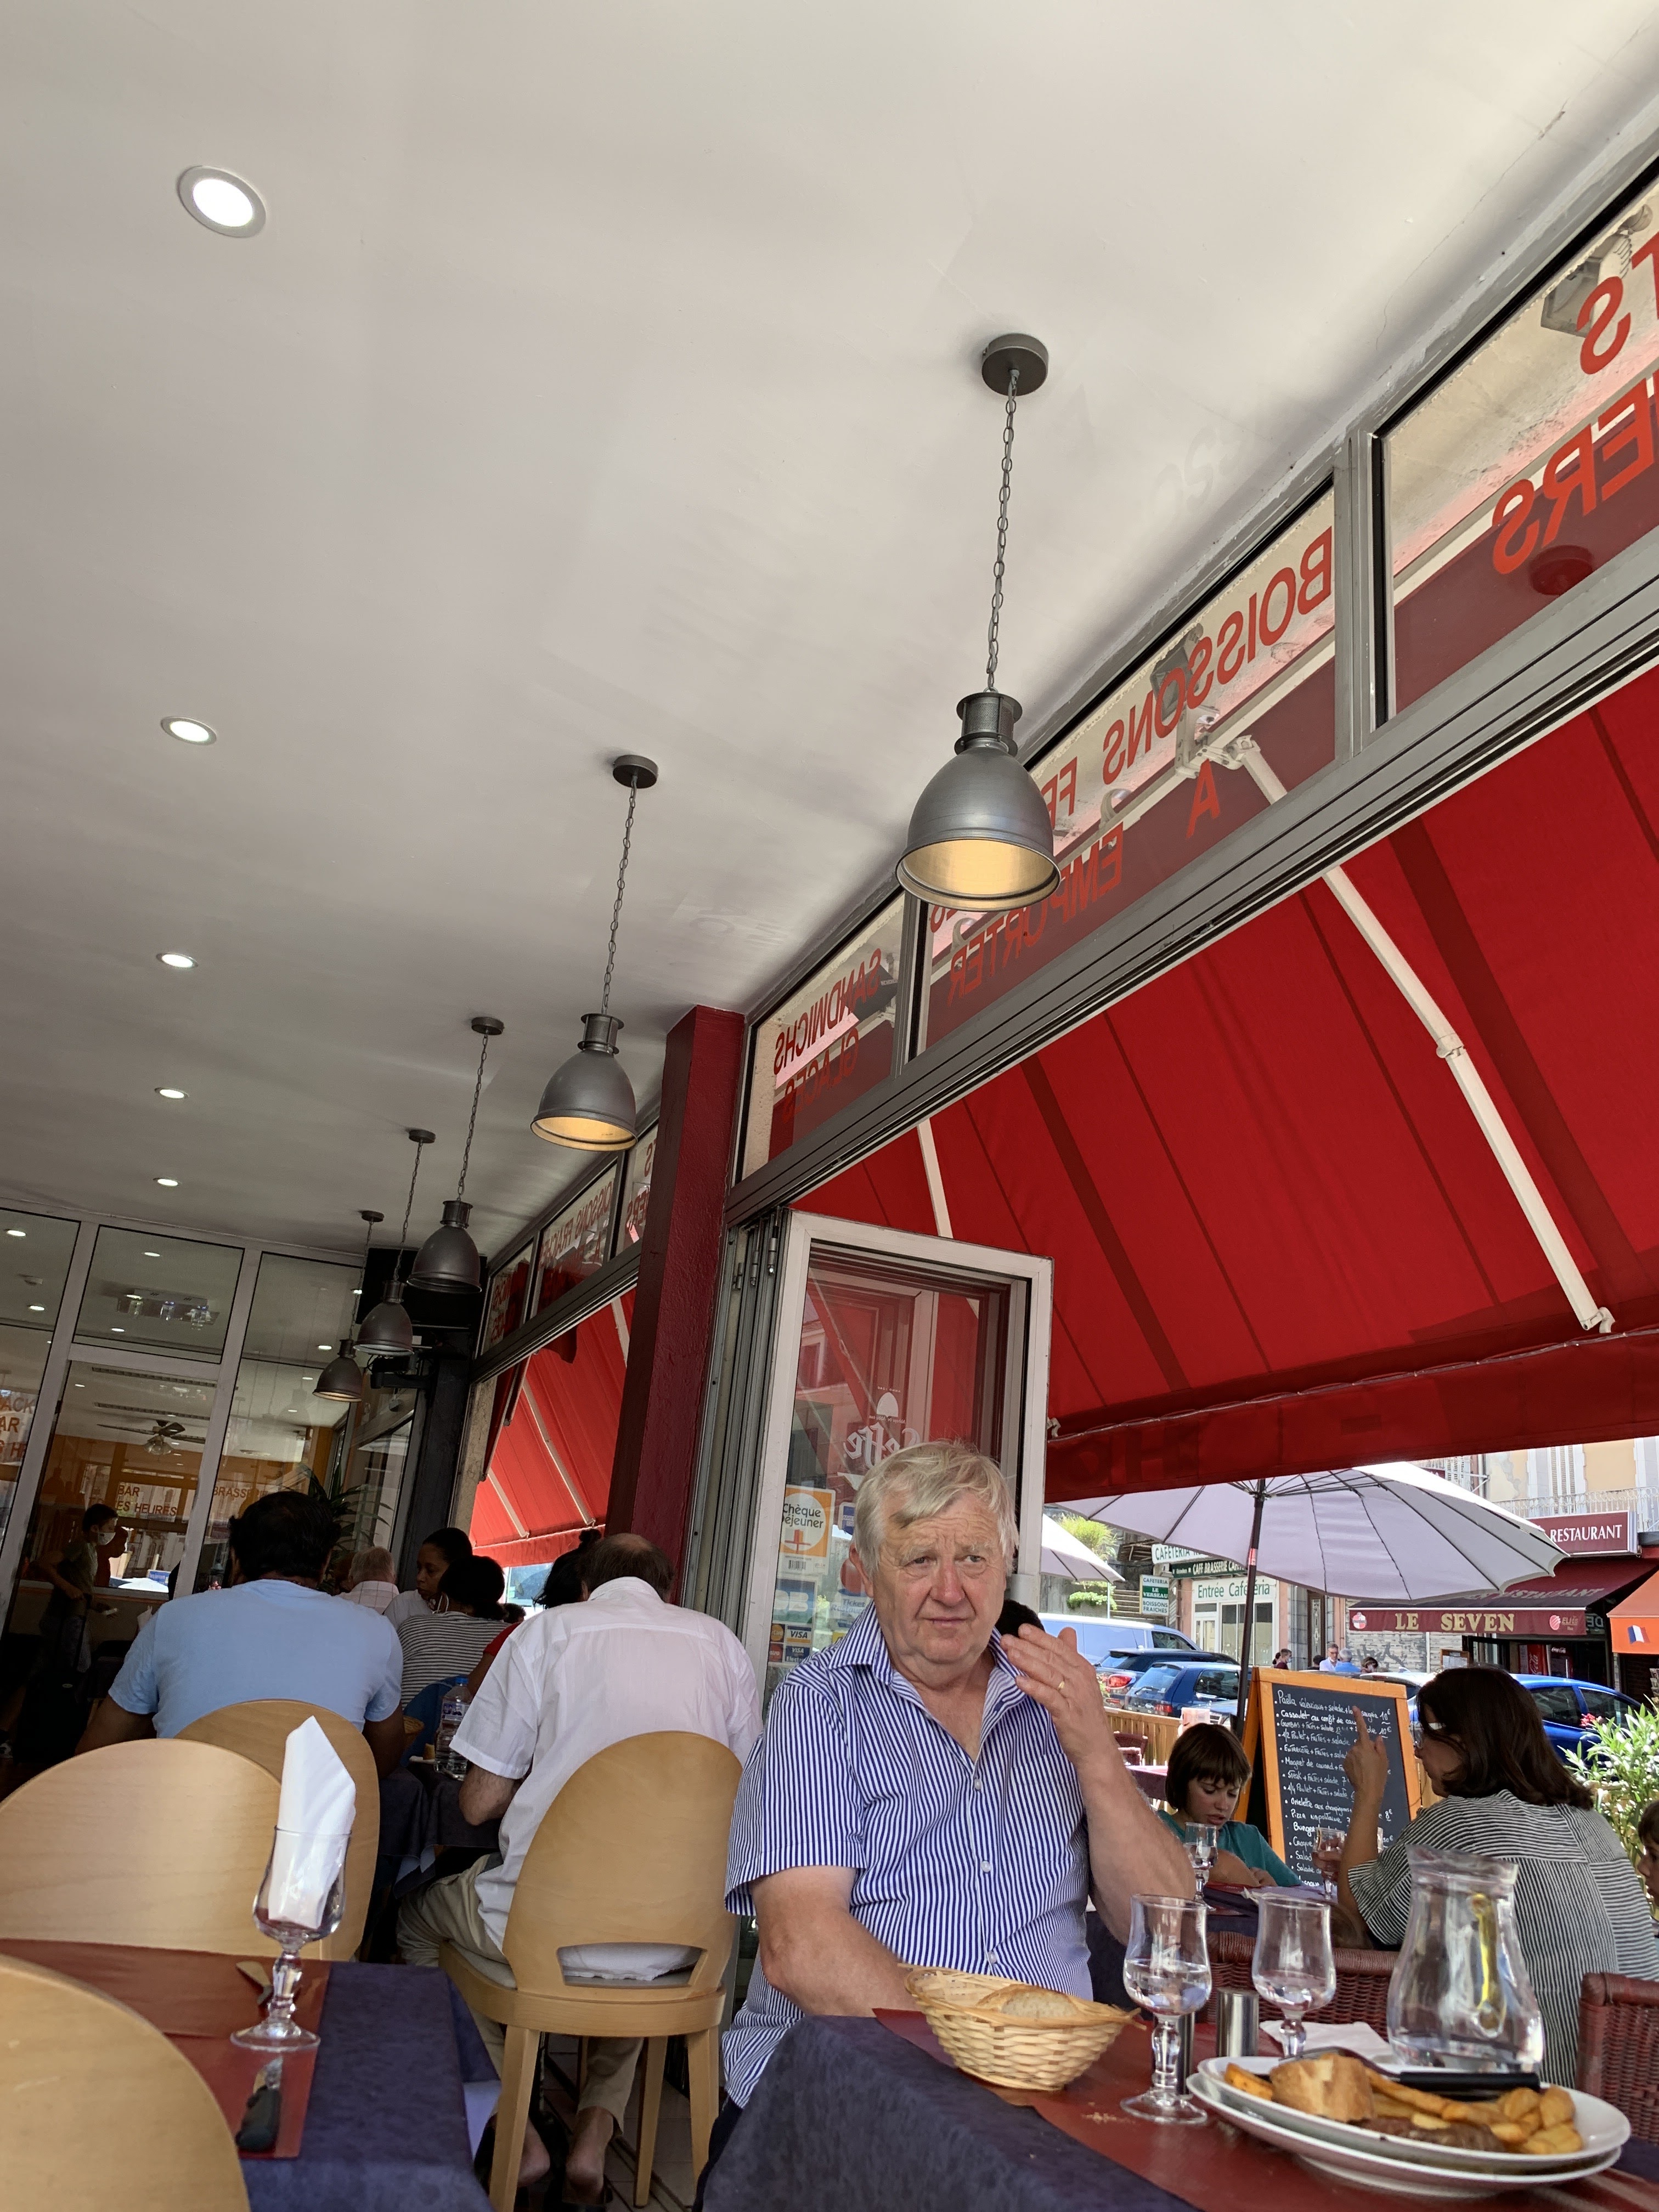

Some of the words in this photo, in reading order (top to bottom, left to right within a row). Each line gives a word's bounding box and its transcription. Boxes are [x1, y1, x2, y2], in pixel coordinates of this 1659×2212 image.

[117, 1485, 140, 1497] BAR
[135, 1502, 178, 1517] HEURES
[783, 1503, 821, 1517] Chèque
[1550, 1524, 1622, 1543] RESTAURANT
[1204, 1560, 1228, 1574] BRASSERIE
[1198, 1583, 1224, 1599] Entrée
[1229, 1579, 1270, 1597] Cafééria
[1395, 1613, 1419, 1630] LE
[1441, 1613, 1514, 1632] SEVEN
[790, 1630, 808, 1639] VISA
[1281, 1709, 1310, 1719] Cassoulet
[1321, 1714, 1335, 1725] confit
[1285, 1757, 1305, 1770] Magret
[1306, 1759, 1314, 1768] de
[1316, 1762, 1334, 1770] canard
[1297, 1863, 1315, 1873] Salade
